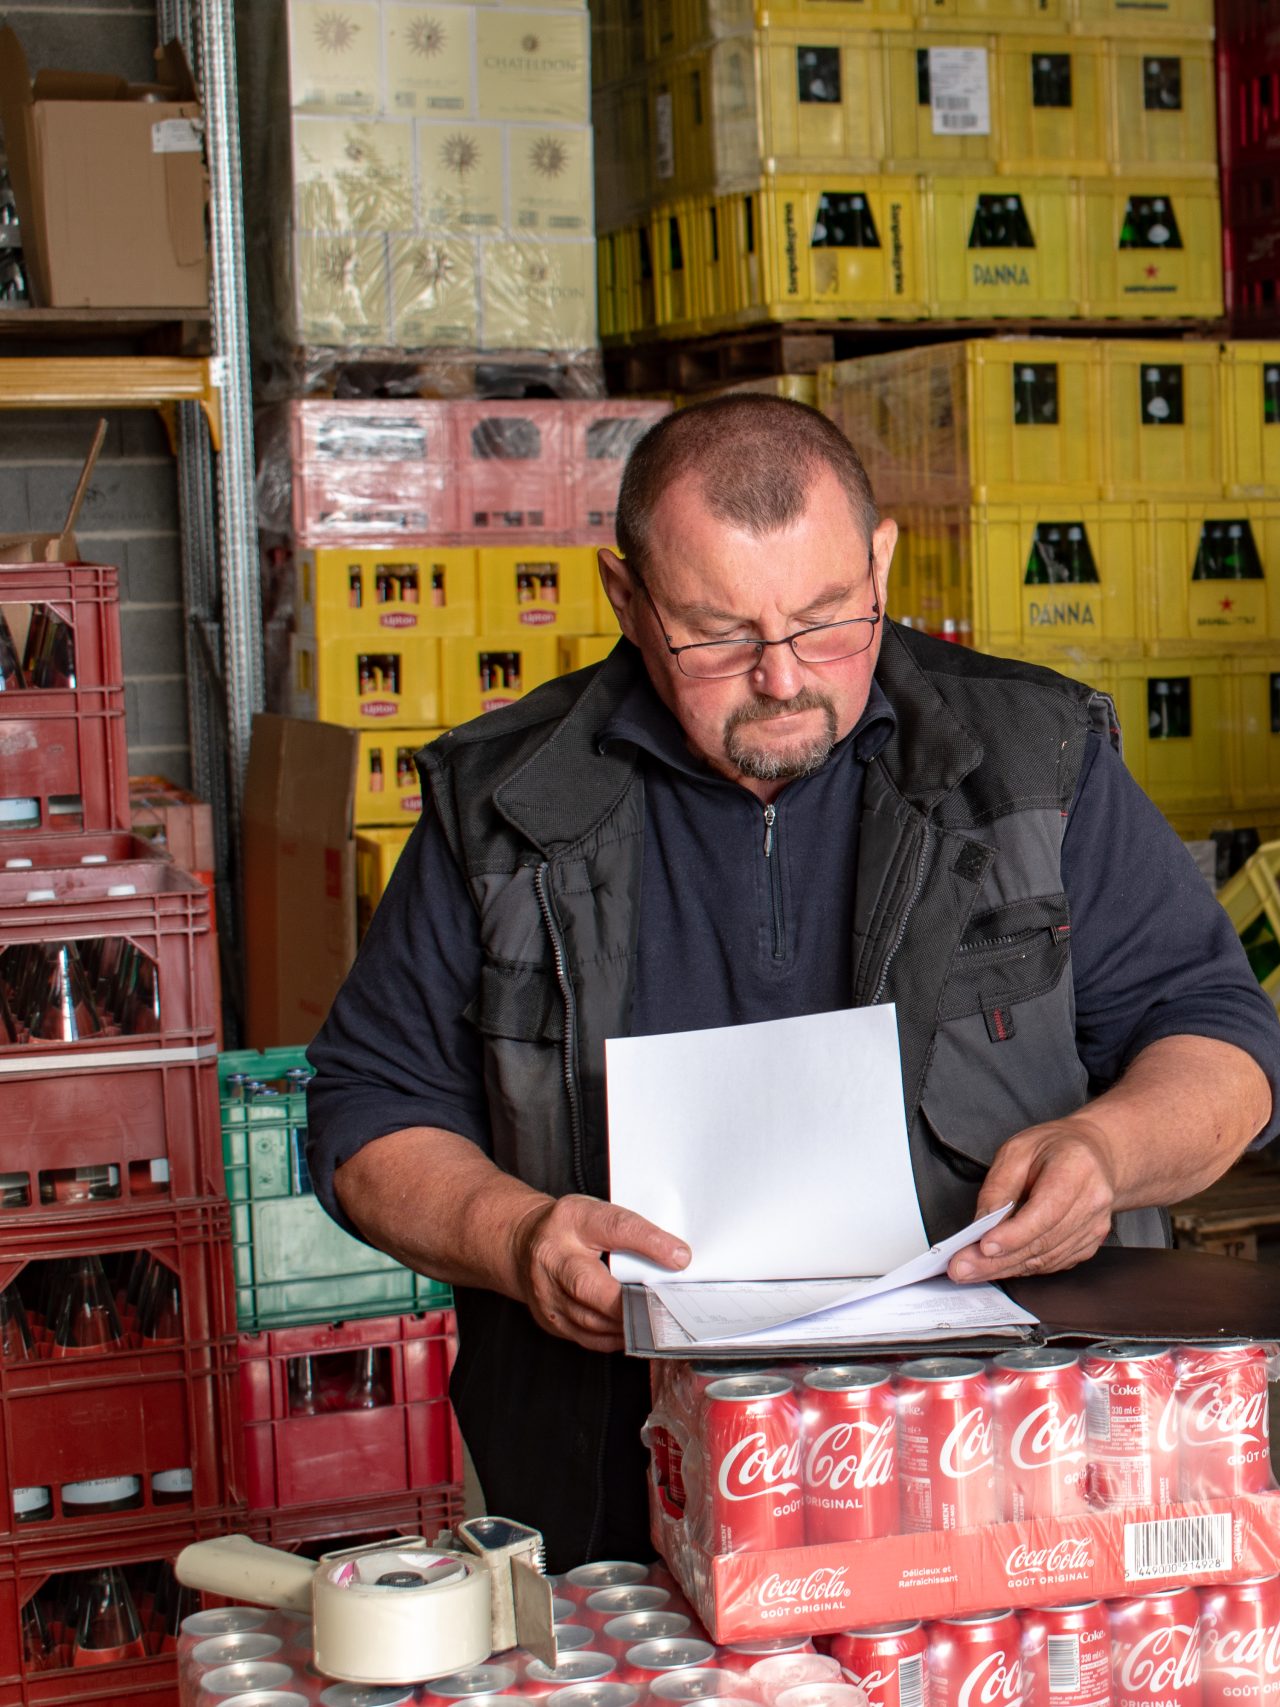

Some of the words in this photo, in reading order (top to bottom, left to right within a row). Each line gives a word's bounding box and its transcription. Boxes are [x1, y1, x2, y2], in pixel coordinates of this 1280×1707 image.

[973, 265, 1030, 286] PANNA
[383, 613, 416, 627] Lipton
[522, 610, 554, 624] Lipton
[1029, 602, 1095, 626] PANNA
[363, 702, 396, 715] Lipton
[1111, 1384, 1141, 1396] Coke
[1004, 1535, 1092, 1575] Coca-Cola
[938, 1565, 951, 1575] et
[1138, 1565, 1177, 1577] 449000
[1182, 1558, 1221, 1571] 214928
[758, 1565, 850, 1606] Coca-Cola
[1008, 1575, 1037, 1588] GOÛT
[1039, 1571, 1089, 1585] ORIGINAL
[760, 1605, 790, 1619] GOÛT
[794, 1601, 846, 1615] ORIGINAL
[1080, 1630, 1104, 1644] Coke
[1223, 1683, 1259, 1698] GOÛT
